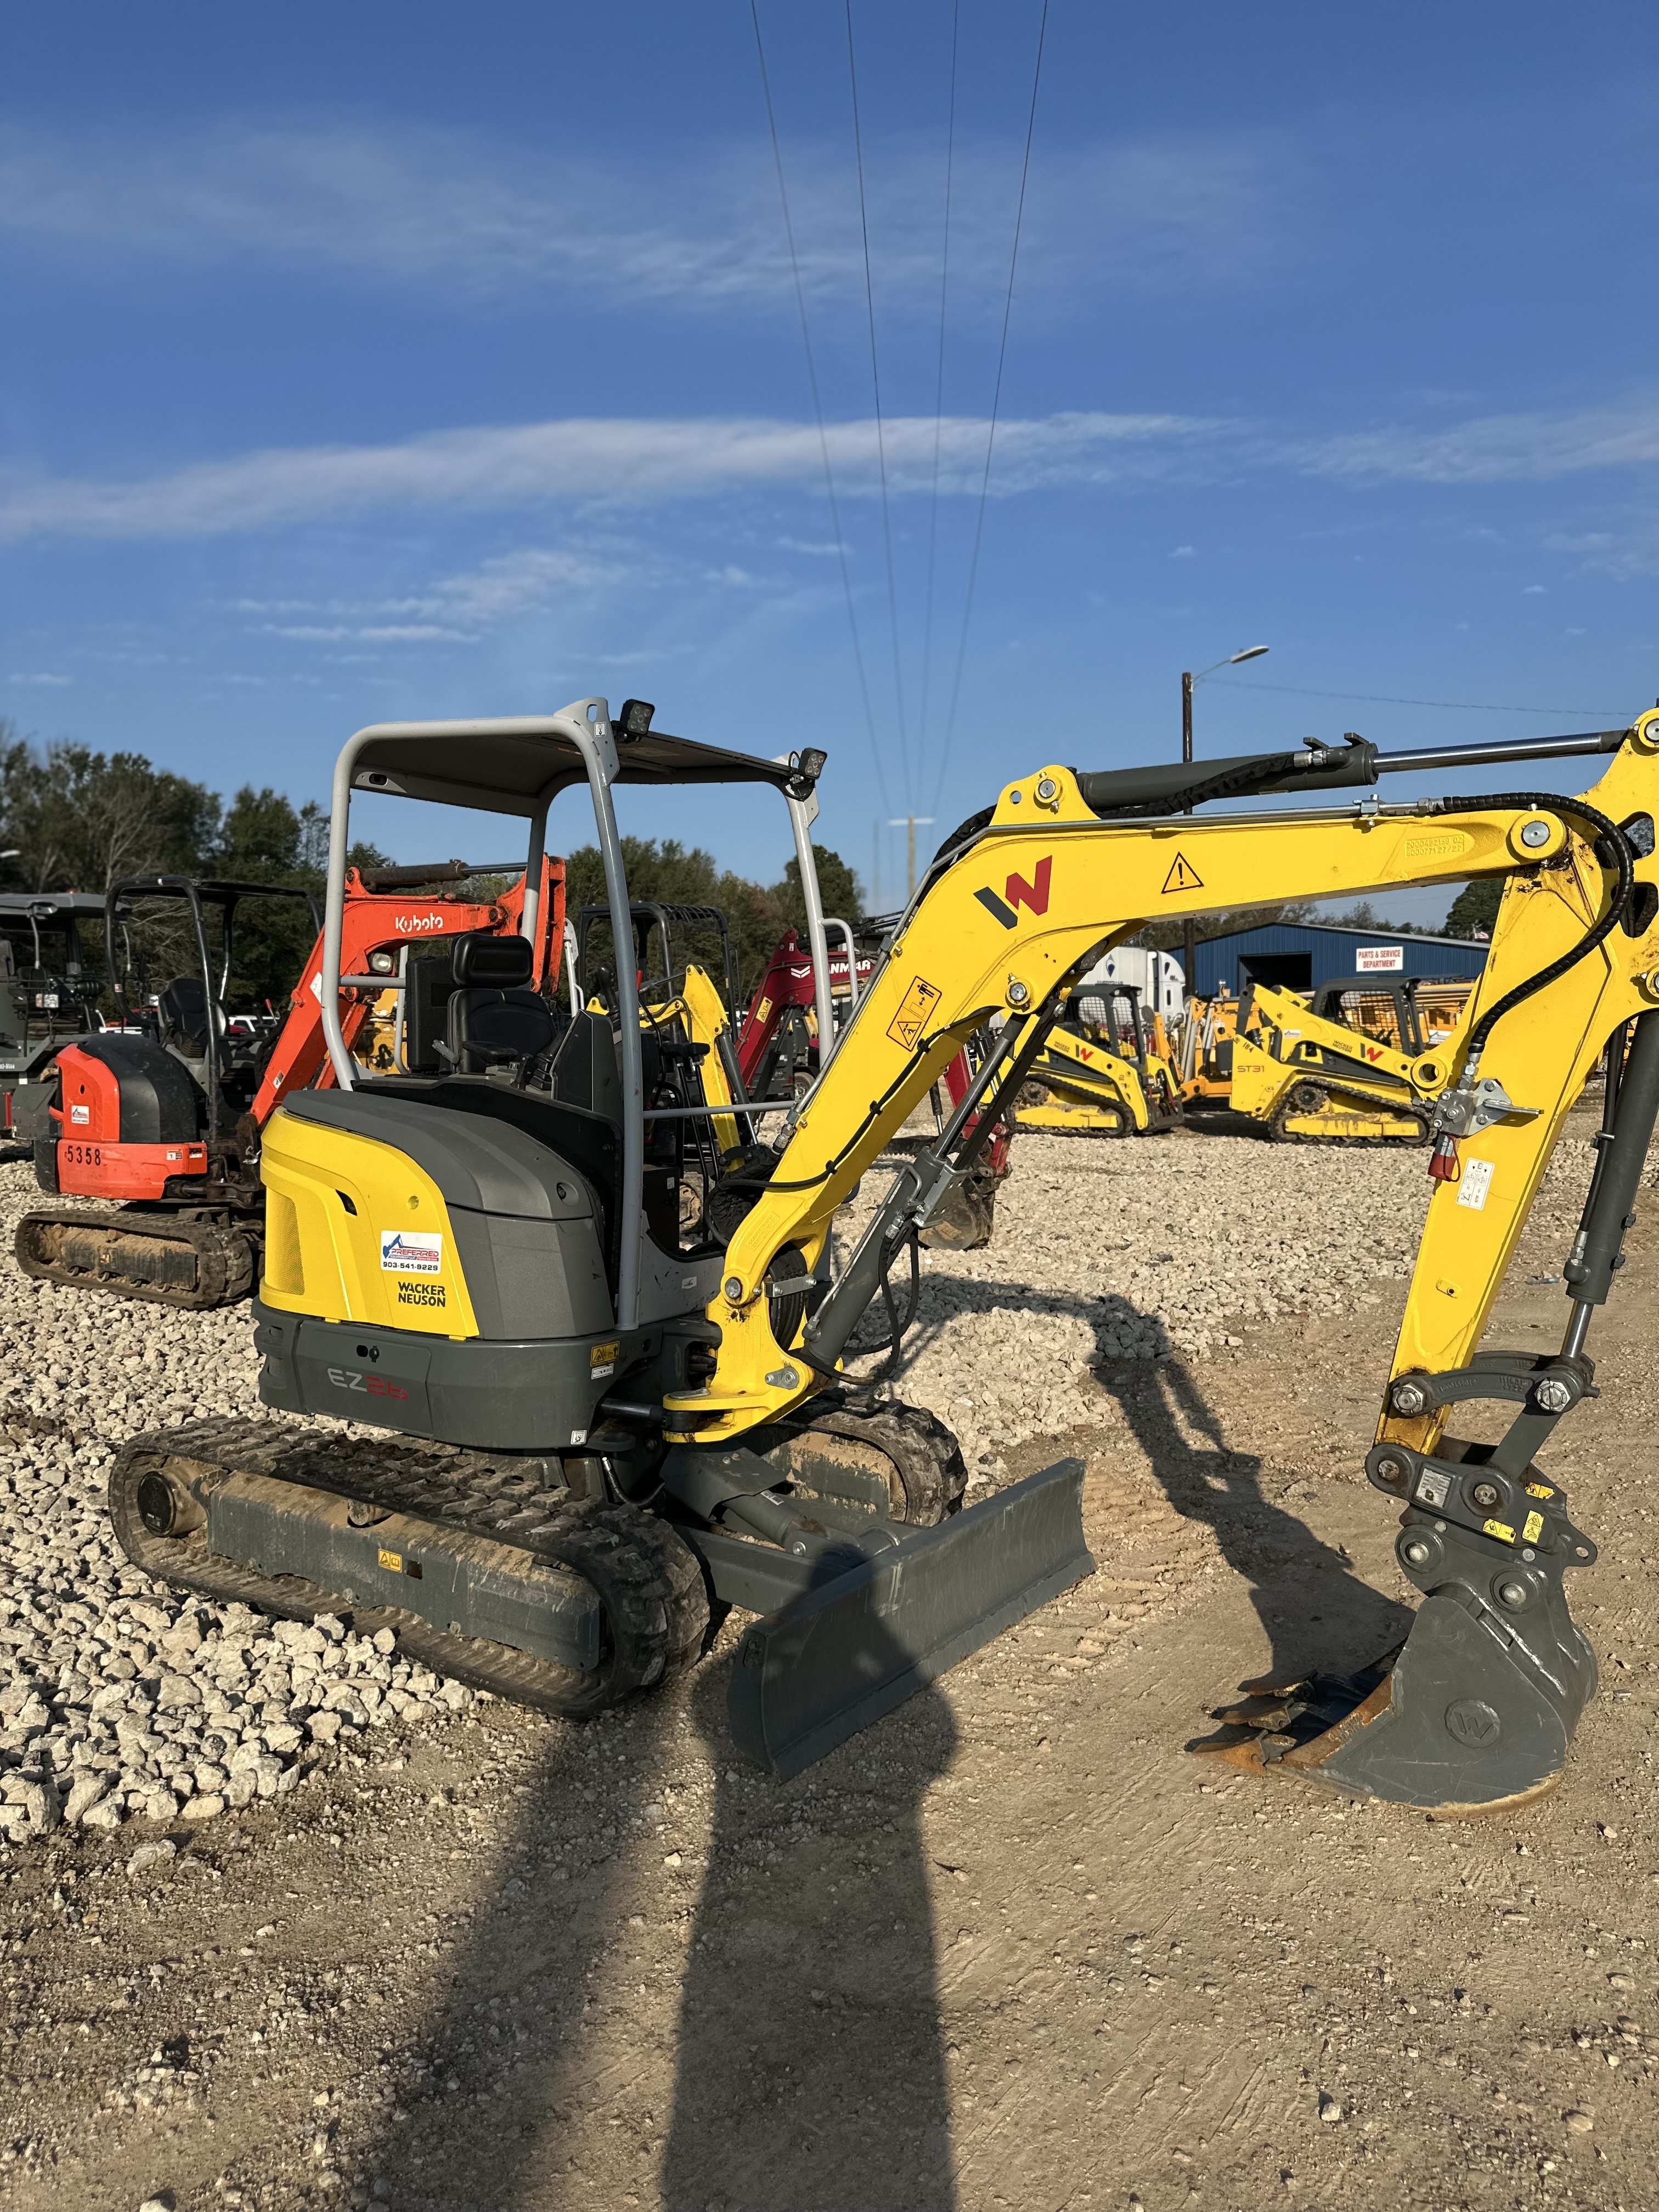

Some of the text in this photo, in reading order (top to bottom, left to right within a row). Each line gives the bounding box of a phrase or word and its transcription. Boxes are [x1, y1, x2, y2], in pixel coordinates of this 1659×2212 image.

[396, 912, 443, 933] Kubota
[1380, 949, 1401, 958] SERVICE
[828, 960, 871, 974] NMAR
[1363, 960, 1396, 968] DEPARTMENT
[67, 1145, 101, 1166] 5358
[391, 1248, 439, 1257] PREFERRED
[398, 1281, 446, 1296] WACKER
[398, 1293, 446, 1307] NEUSON
[328, 1368, 408, 1400] EZ26
